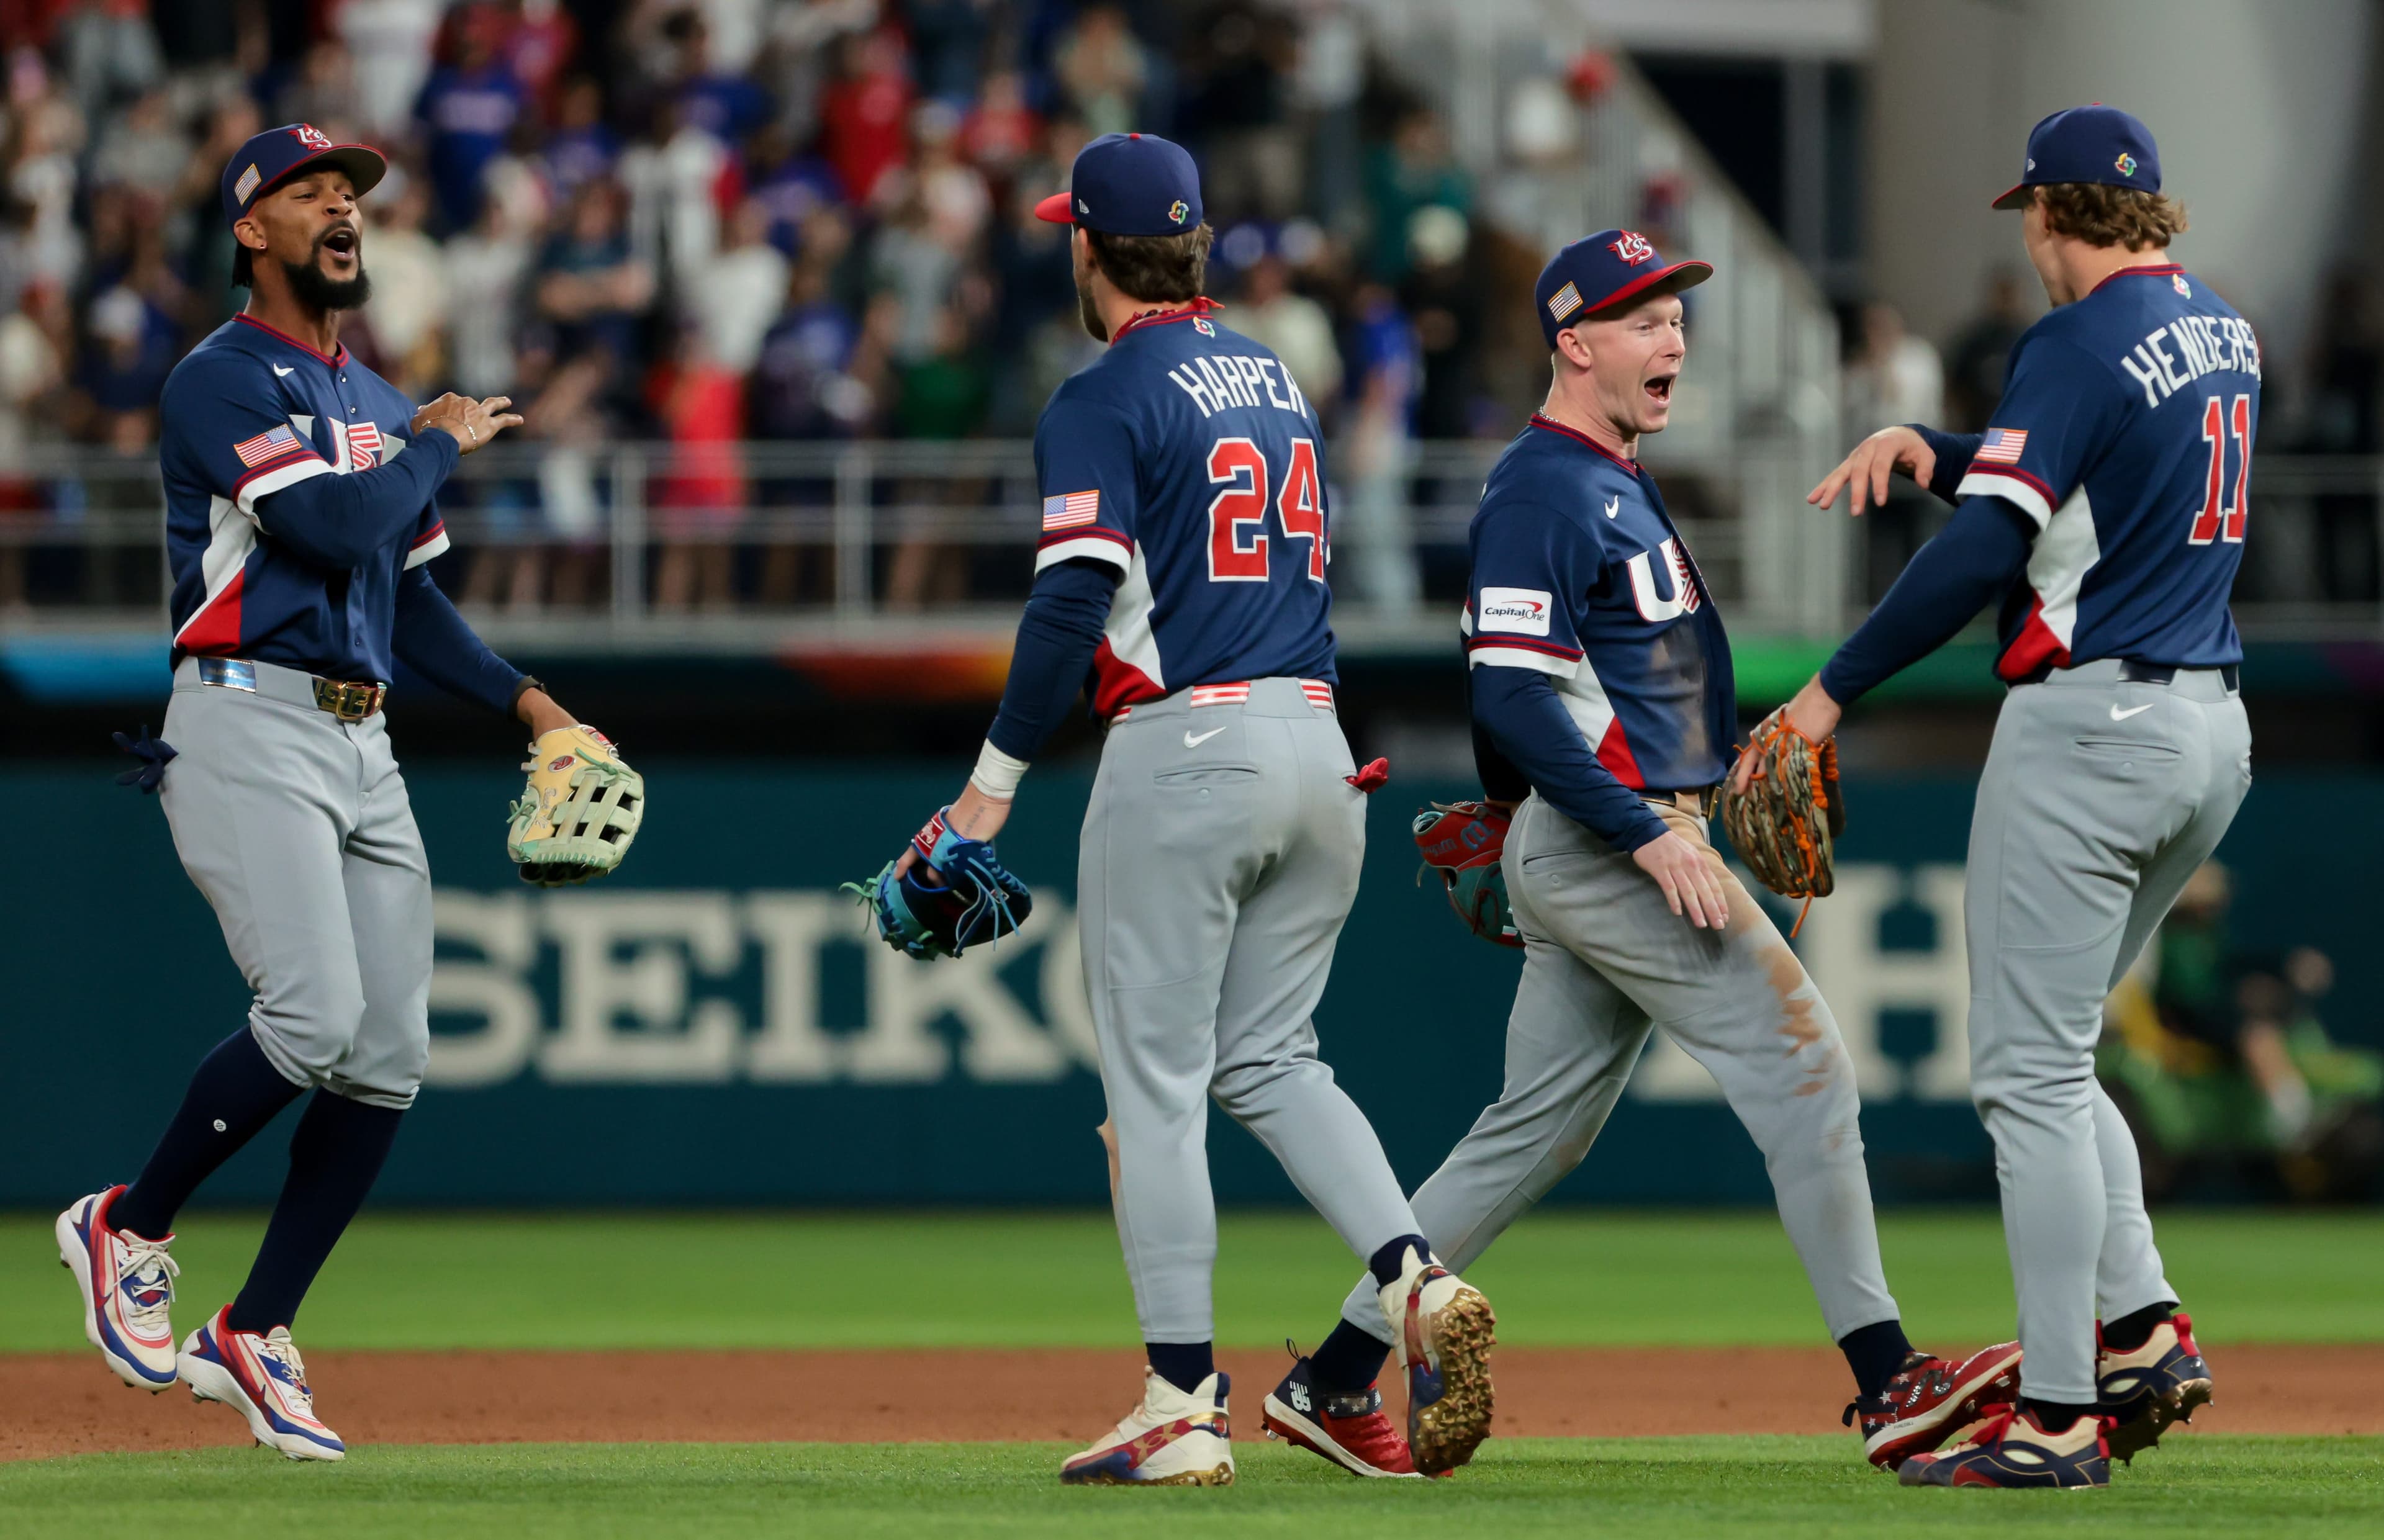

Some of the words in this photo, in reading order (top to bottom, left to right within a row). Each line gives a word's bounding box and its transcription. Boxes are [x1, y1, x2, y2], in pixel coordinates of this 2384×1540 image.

[2120, 315, 2261, 409] HENDERS
[1207, 437, 1324, 585] 24
[2187, 393, 2251, 545] 11
